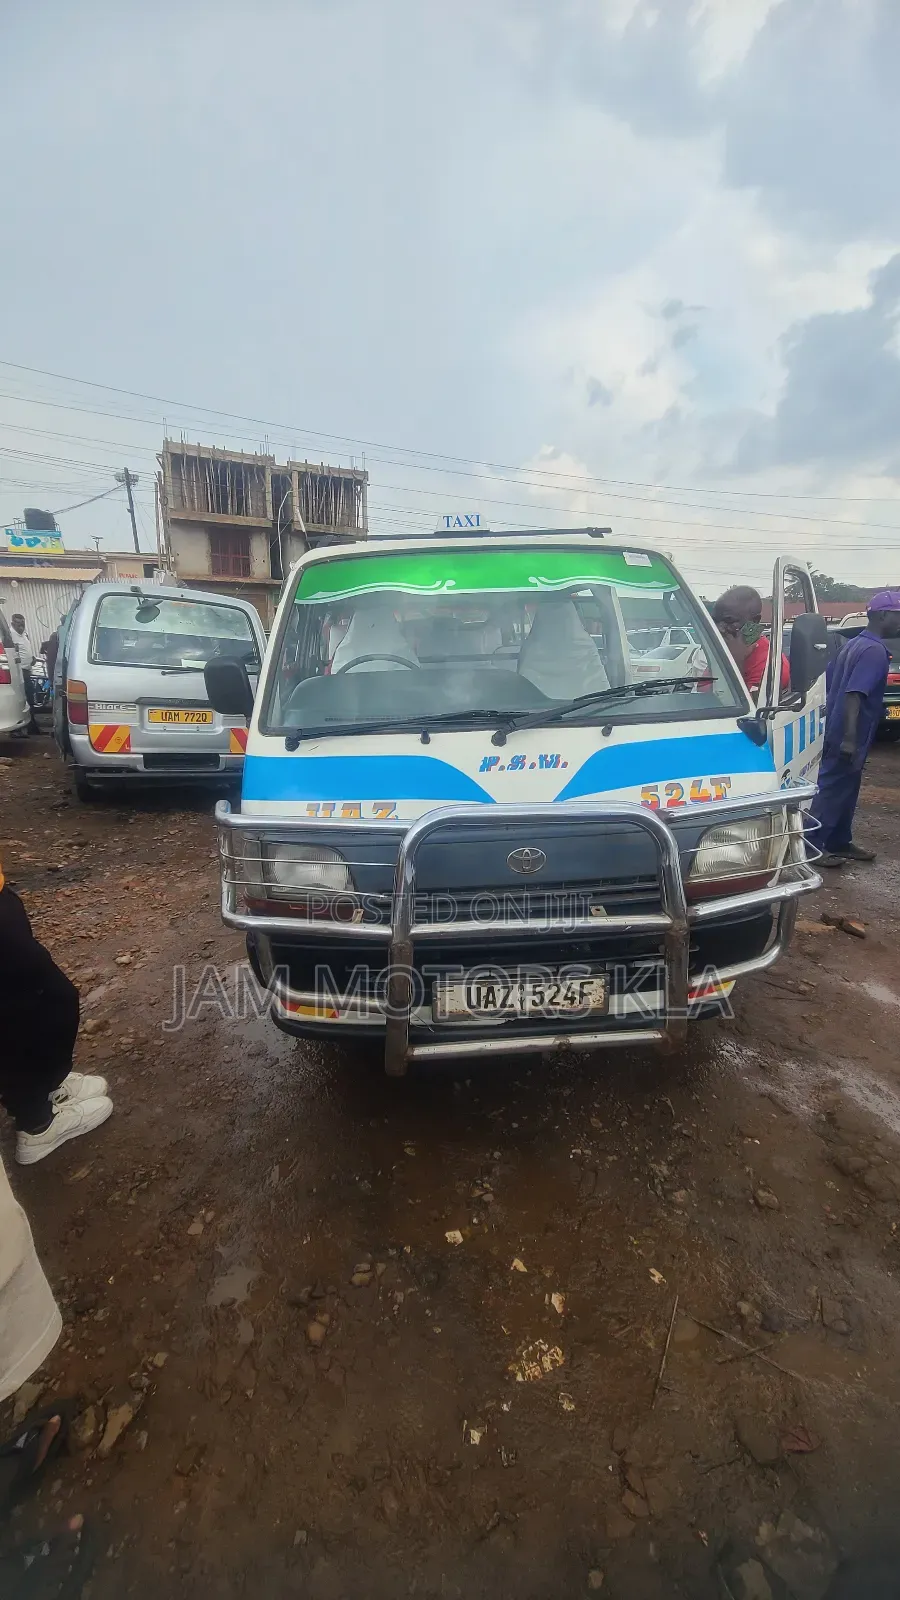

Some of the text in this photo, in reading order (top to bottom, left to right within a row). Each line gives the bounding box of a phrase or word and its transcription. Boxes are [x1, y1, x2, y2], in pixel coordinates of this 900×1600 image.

[442, 513, 481, 528] TAXI
[161, 711, 208, 723] UAM 772Q
[640, 776, 732, 811] 524F
[466, 980, 594, 1009] UAZ 524F
